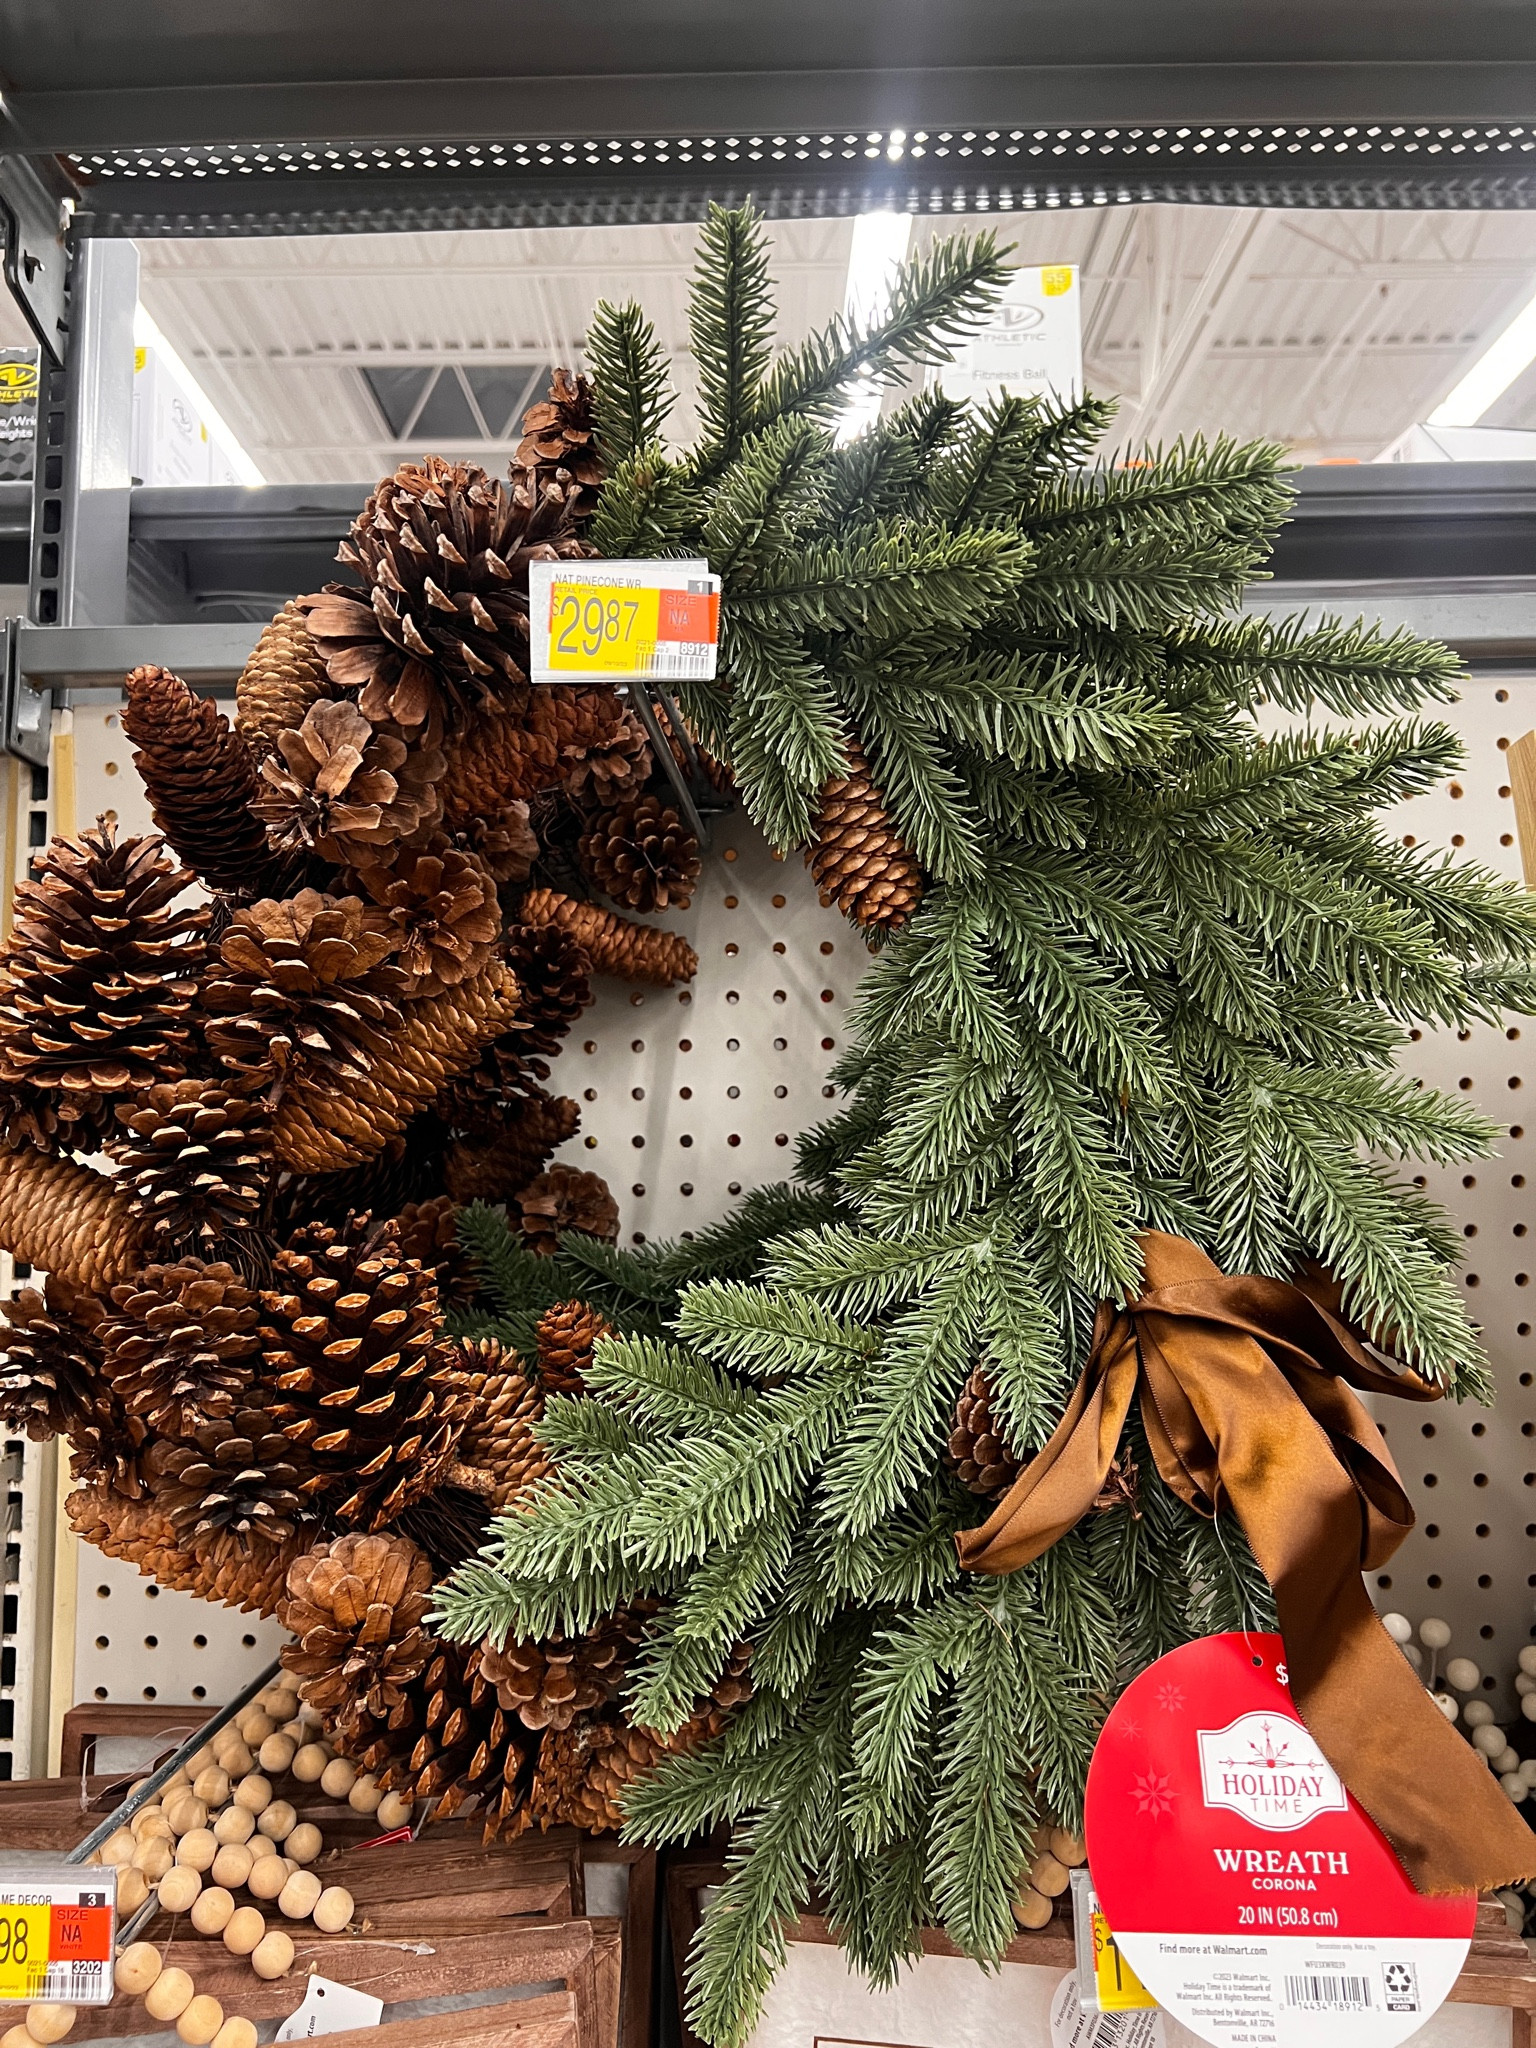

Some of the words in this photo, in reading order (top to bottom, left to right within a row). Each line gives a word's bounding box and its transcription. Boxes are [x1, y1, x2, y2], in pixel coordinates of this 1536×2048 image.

[972, 370, 1020, 380] Fitness
[1023, 369, 1046, 379] Ball
[555, 573, 575, 586] NAT
[576, 575, 624, 588] PINECONE
[626, 578, 642, 590] WR
[579, 588, 598, 596] PRICE
[666, 594, 697, 607] SIZE
[669, 608, 690, 626] NA
[680, 642, 708, 656] 8912
[1276, 1662, 1288, 1686] $
[1223, 1773, 1324, 1798] HOLIDAY
[1250, 1798, 1304, 1814] TIME
[1213, 1848, 1350, 1876] WREATH
[1252, 1877, 1317, 1891] CORONA
[19, 1894, 52, 1906] DECOR
[87, 1894, 97, 1906] 3
[56, 1909, 89, 1921] SIZE
[1238, 1905, 1255, 1924] 20
[1258, 1907, 1274, 1925] IN
[1276, 1906, 1310, 1927] (50.8
[1312, 1908, 1338, 1928] cm)
[61, 1924, 82, 1942] NA
[1160, 1943, 1178, 1954] Find
[1180, 1946, 1200, 1954] more
[1202, 1946, 1212, 1954] at
[1212, 1945, 1268, 1956] Walmart.com
[73, 1960, 102, 1974] 3202
[1183, 1982, 1206, 1991] Holiday
[1224, 1994, 1243, 2002] Rights
[1234, 2008, 1260, 2016] Walmart
